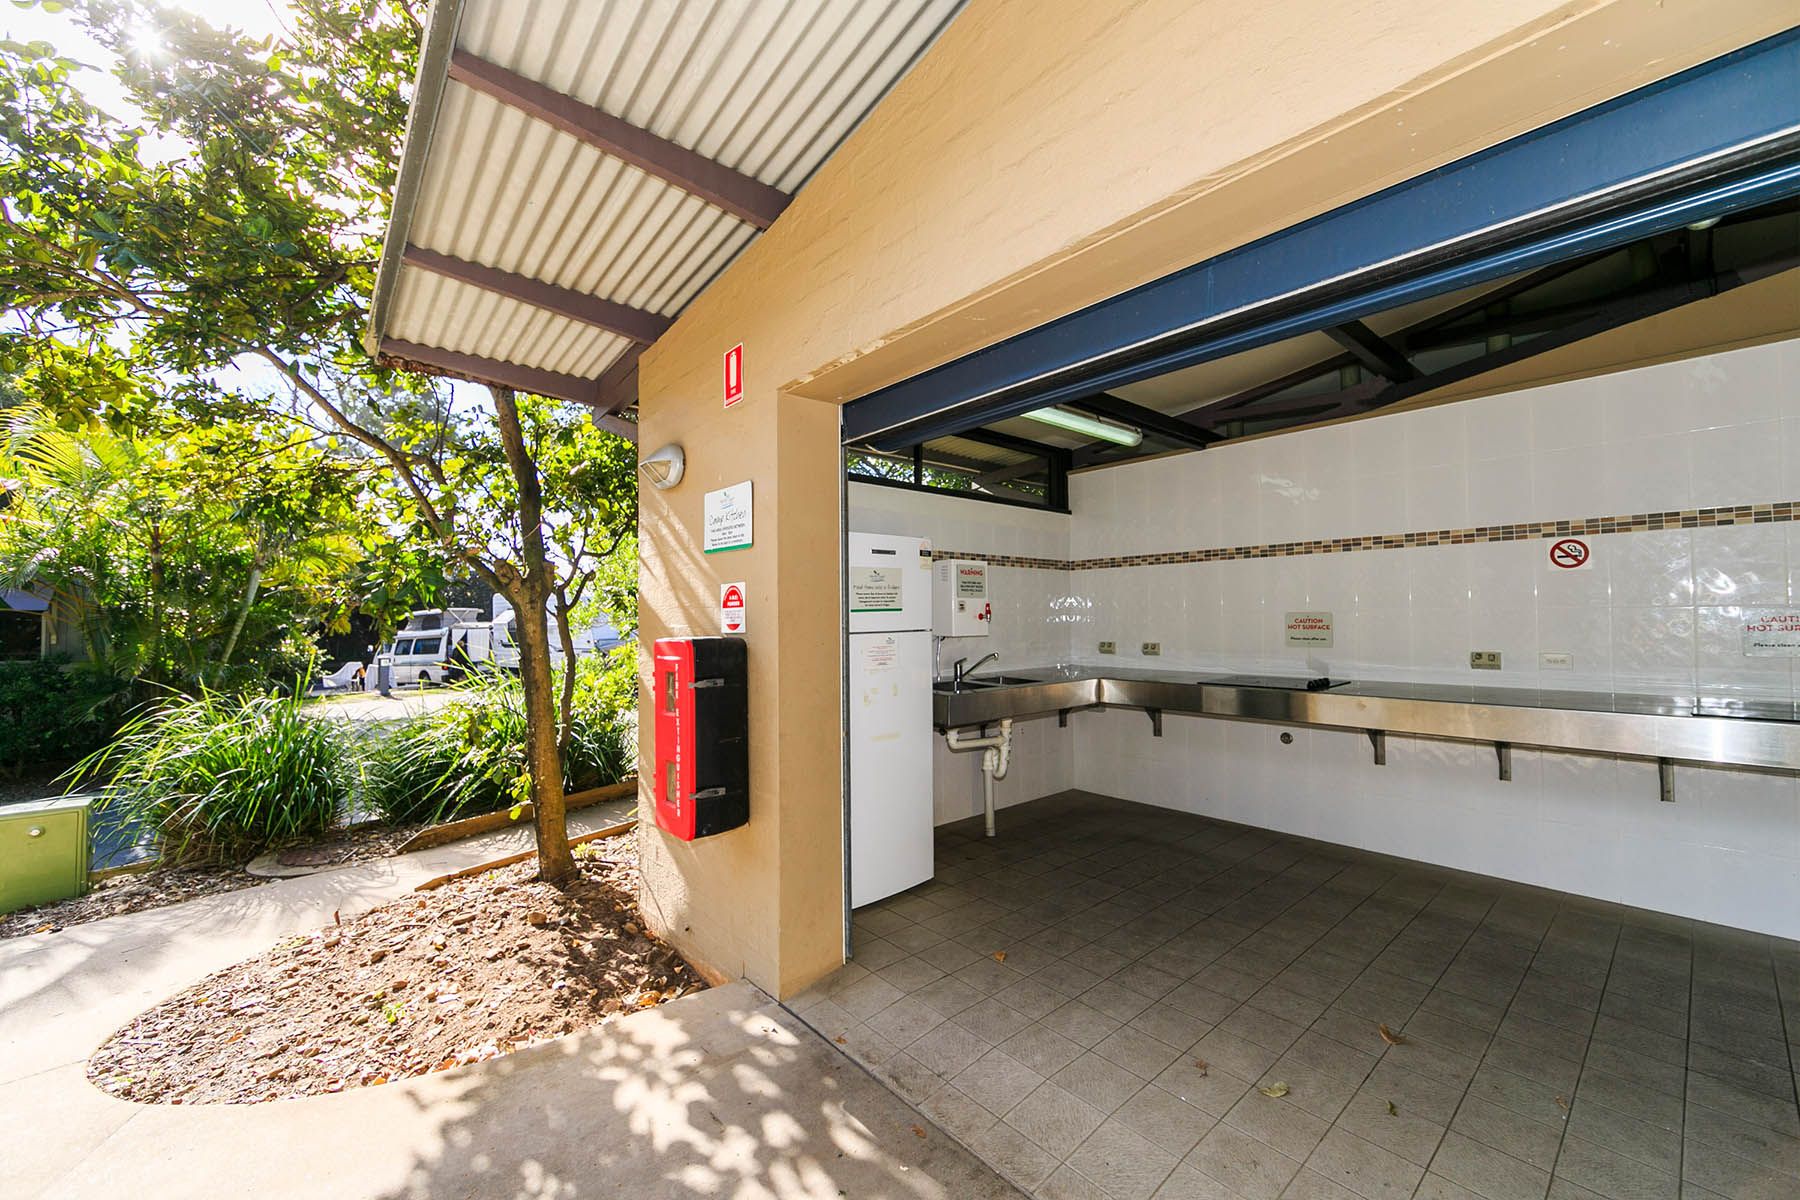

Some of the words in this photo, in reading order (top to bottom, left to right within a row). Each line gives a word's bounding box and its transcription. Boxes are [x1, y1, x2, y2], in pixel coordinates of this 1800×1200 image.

[959, 569, 984, 577] WARNING
[1760, 615, 1800, 623] CAUTI
[1746, 624, 1772, 632] HOT
